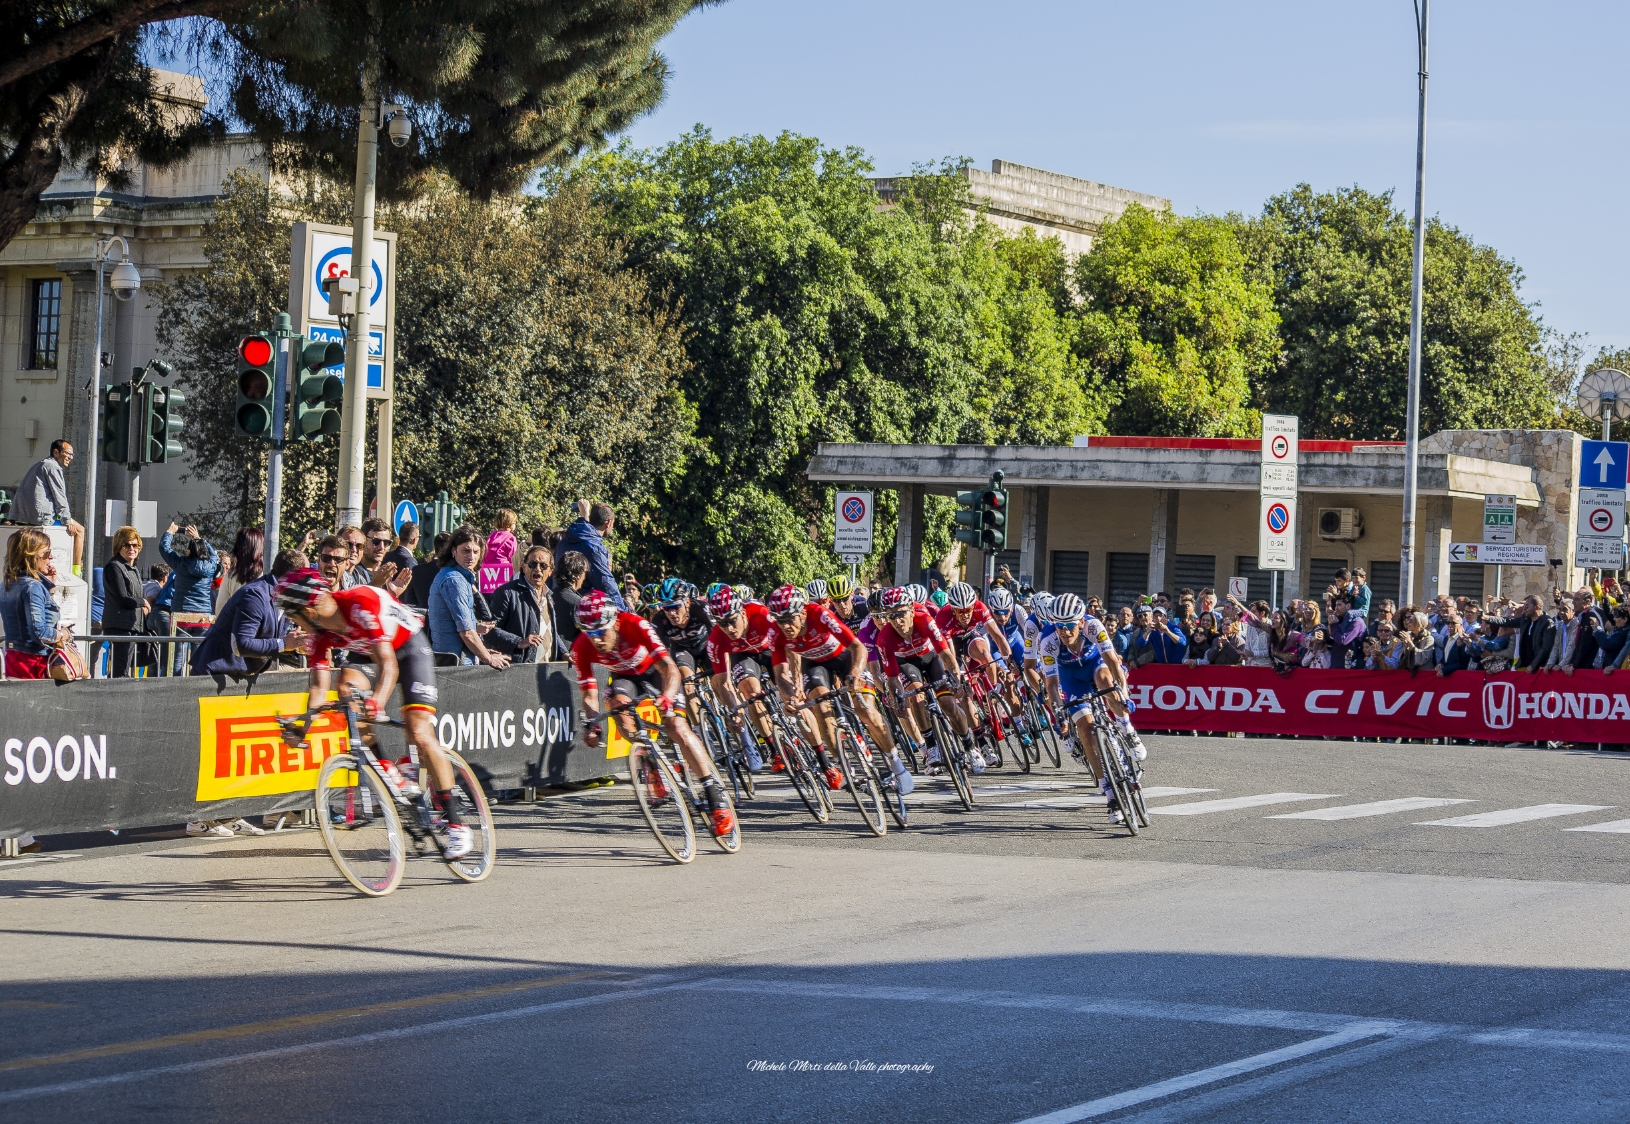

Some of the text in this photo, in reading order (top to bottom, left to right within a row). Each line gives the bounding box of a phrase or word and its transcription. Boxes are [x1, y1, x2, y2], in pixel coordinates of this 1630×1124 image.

[1488, 515, 1496, 524] A
[483, 567, 501, 582] W
[1129, 684, 1286, 714] HONDA
[1304, 689, 1471, 718] CIVIC
[1517, 691, 1630, 721] HONDA
[428, 709, 516, 751] OMING
[522, 706, 574, 747] SOON.
[4, 735, 117, 786] SOON.
